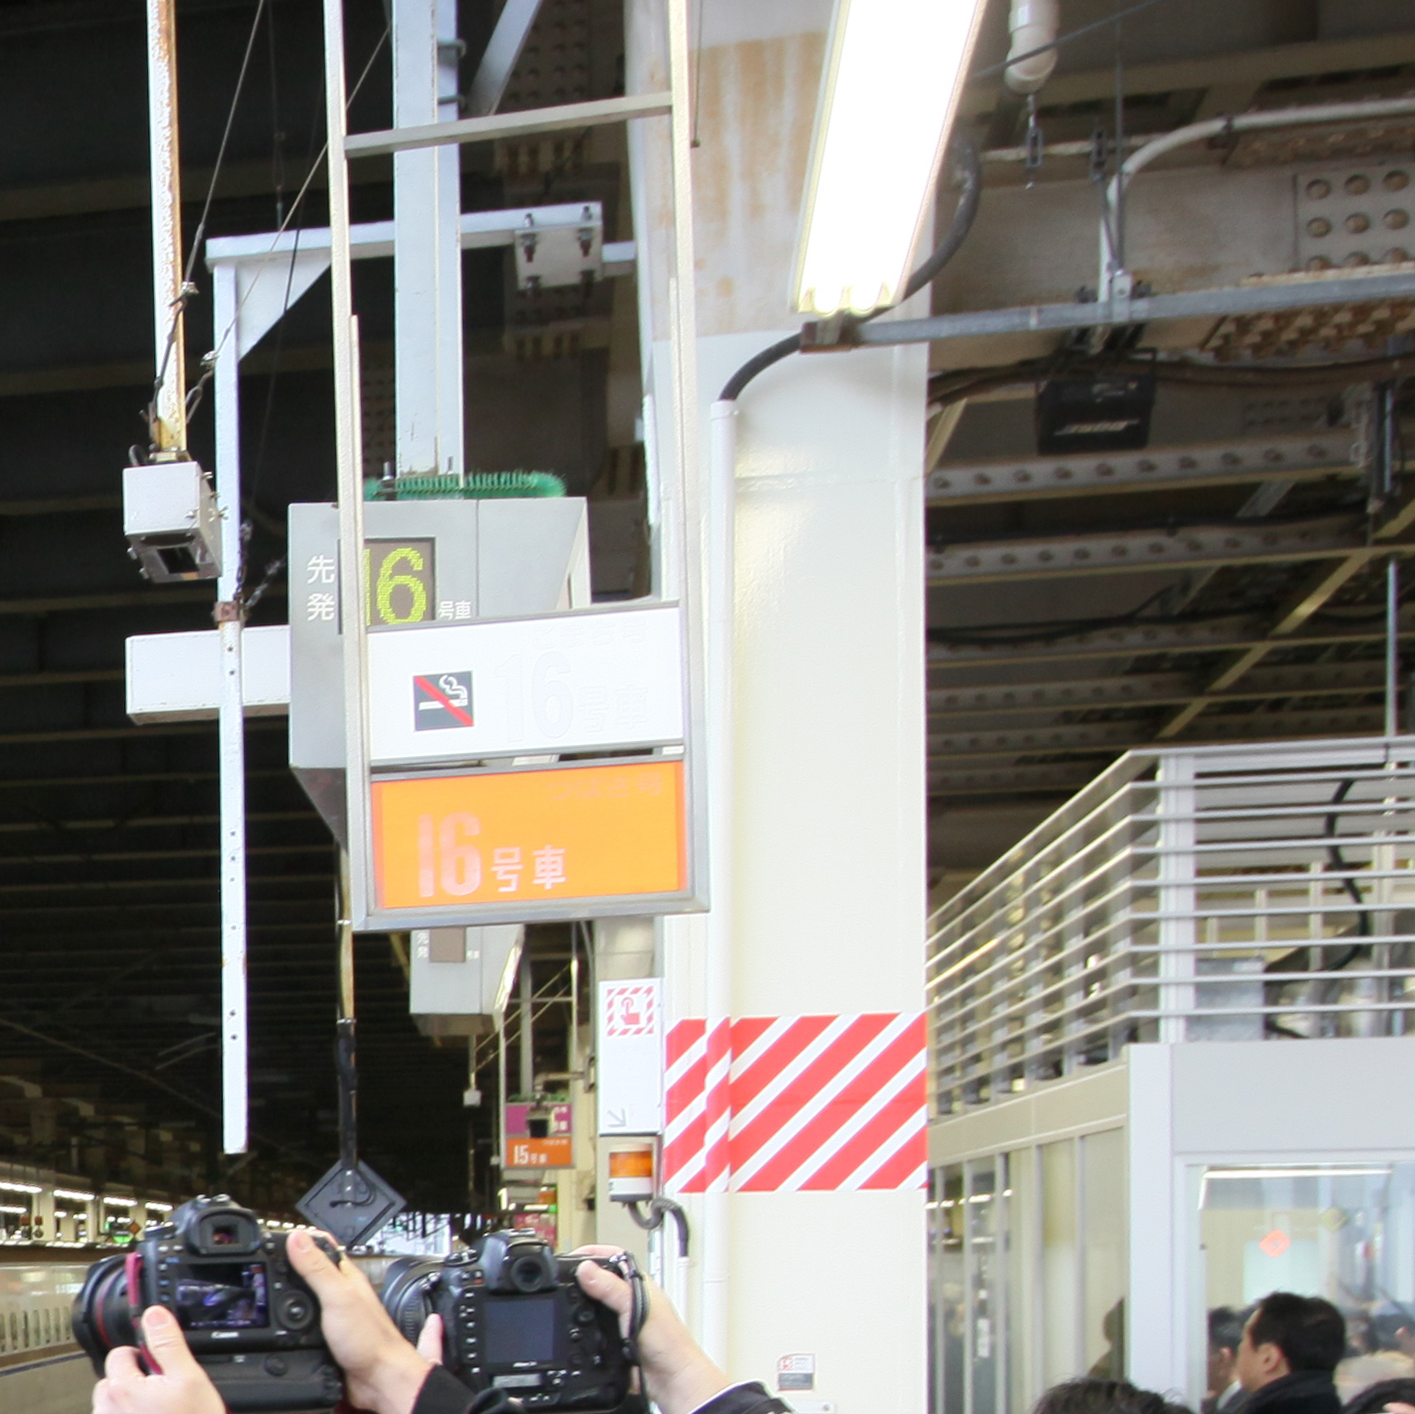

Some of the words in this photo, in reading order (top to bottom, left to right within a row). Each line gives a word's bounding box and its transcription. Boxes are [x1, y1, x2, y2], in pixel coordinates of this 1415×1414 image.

[306, 554, 336, 622] 先発
[437, 600, 472, 621] 号車
[417, 810, 567, 898] 16号車
